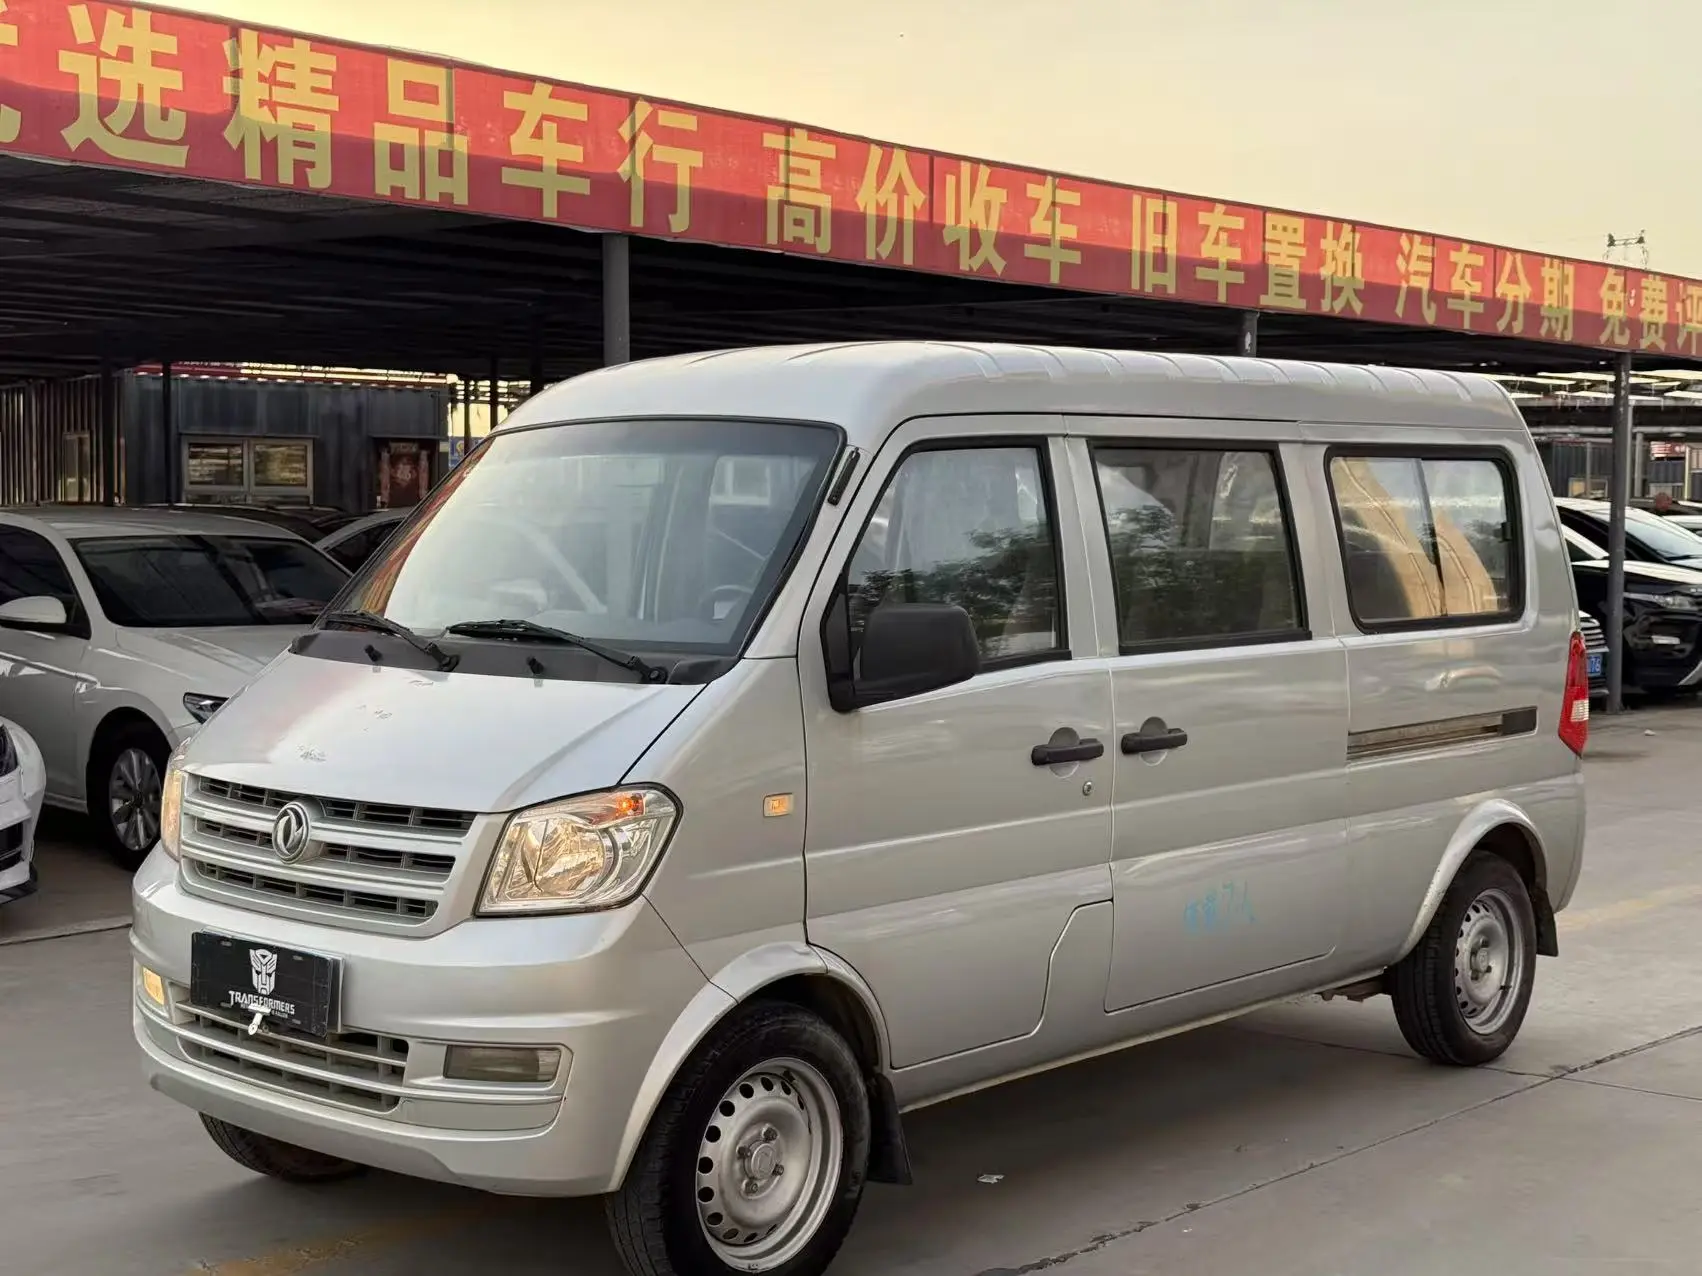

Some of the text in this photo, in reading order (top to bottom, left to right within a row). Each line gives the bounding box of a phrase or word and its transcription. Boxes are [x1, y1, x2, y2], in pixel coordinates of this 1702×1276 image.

[763, 129, 1082, 285] 高价收车
[1131, 194, 1364, 314] 旧车置换
[1395, 234, 1575, 341] 汽车分期
[228, 990, 295, 1015] TRANSFORMERS
